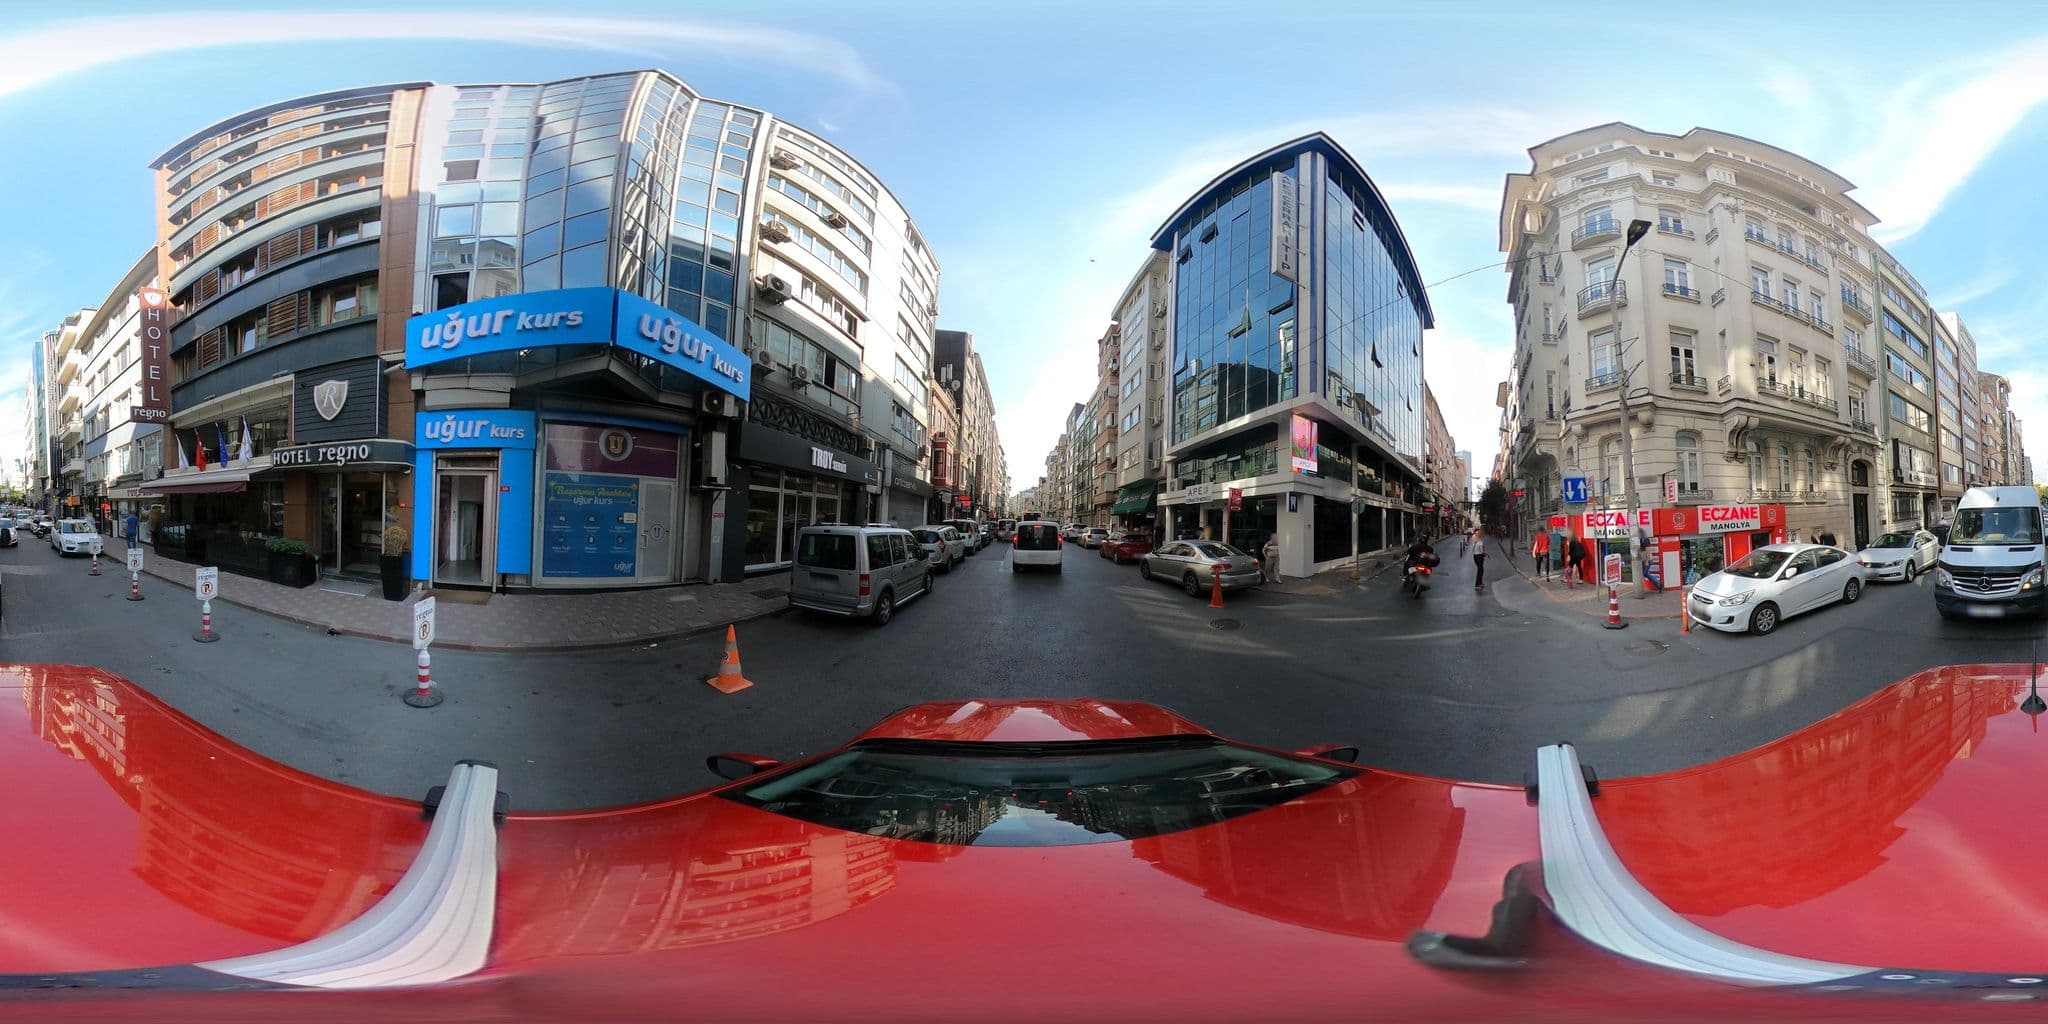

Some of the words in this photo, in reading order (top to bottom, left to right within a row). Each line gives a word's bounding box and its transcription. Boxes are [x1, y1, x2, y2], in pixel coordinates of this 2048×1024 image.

[421, 310, 515, 349] uğur
[516, 311, 584, 331] kurs
[147, 308, 161, 401] HOTEL
[640, 313, 713, 363] uğur
[714, 354, 744, 383] kurs
[133, 407, 166, 420] regno
[425, 415, 490, 443] uğur
[490, 424, 526, 439] kurs
[273, 449, 311, 465] HOTEL
[318, 444, 369, 466] regno
[811, 446, 833, 470] TROY
[1702, 507, 1758, 521] ECZANE
[1711, 522, 1750, 530] MANOLYA
